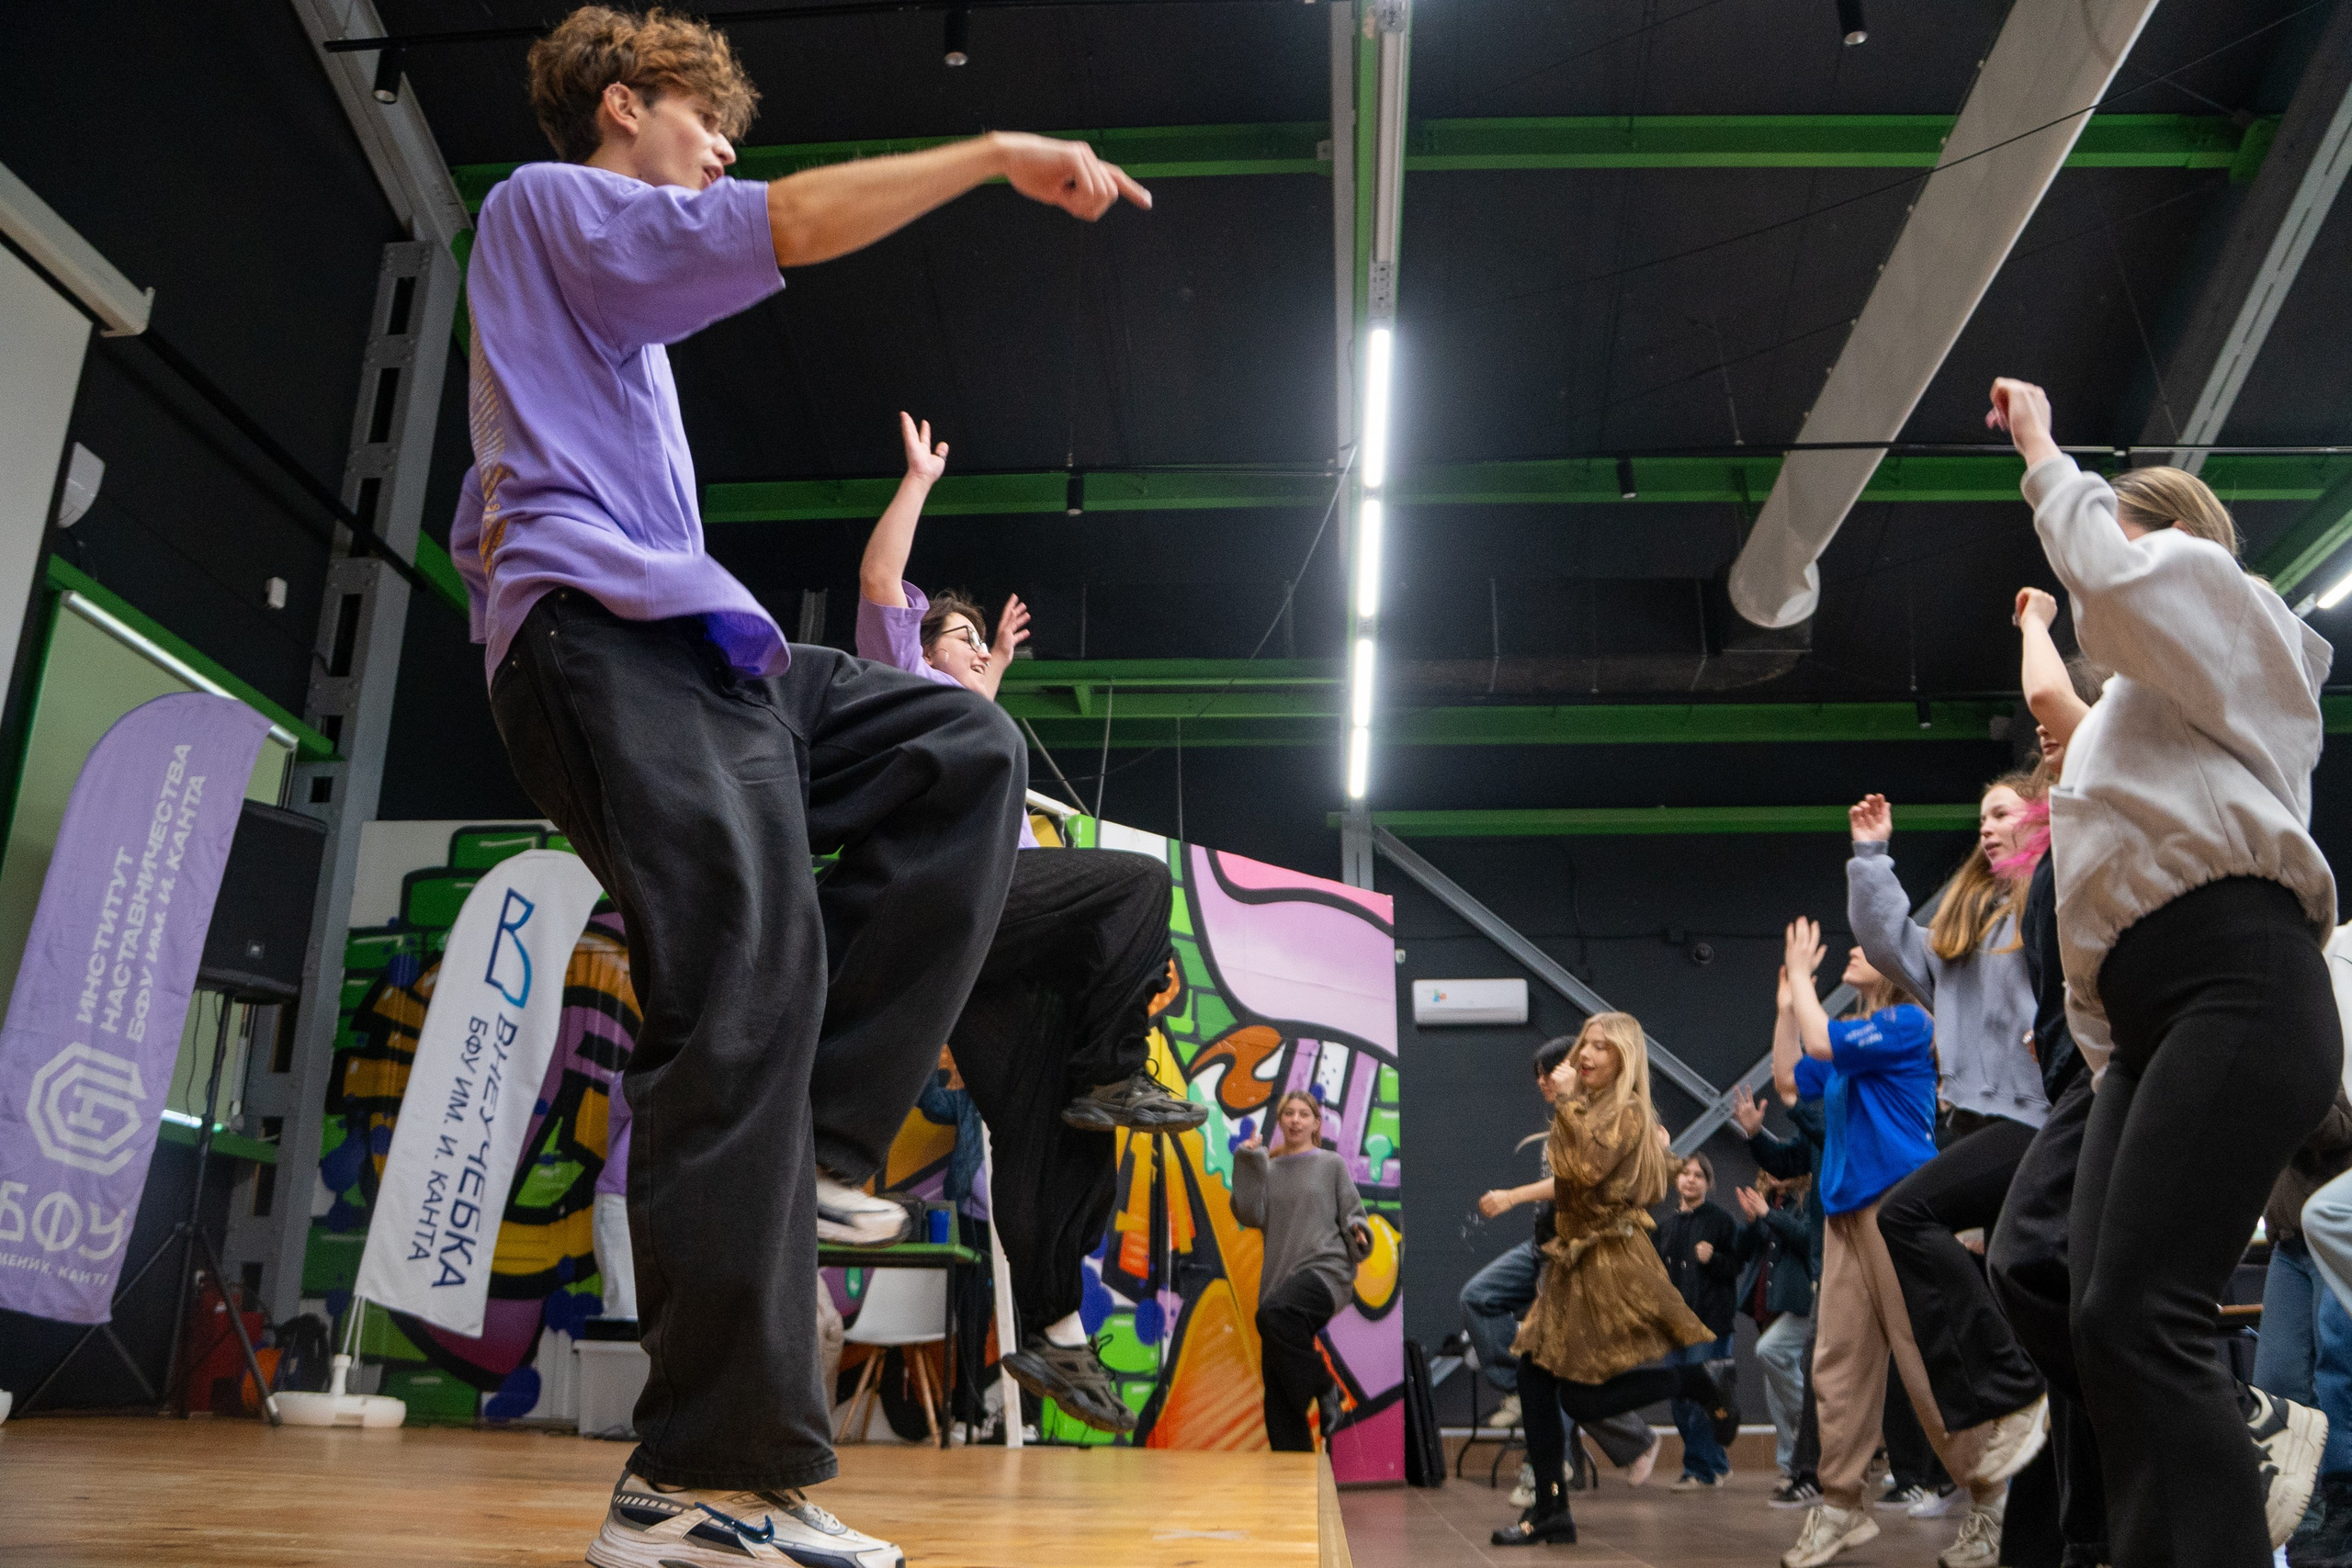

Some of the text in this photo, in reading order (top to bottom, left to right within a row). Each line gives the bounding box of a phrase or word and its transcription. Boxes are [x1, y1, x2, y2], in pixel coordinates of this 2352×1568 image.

[76, 846, 133, 1024] ИНСТИТУТ
[100, 744, 192, 1033] НАСТАВНИЧЕСТВА
[127, 965, 154, 1043] БФУ
[166, 775, 207, 872] КАНТА
[0, 1180, 128, 1261] БФУ
[407, 1016, 489, 1260] БФУ ИМ. И. КАНТА
[432, 1012, 518, 1287] ВНЕУЧЕБКА
